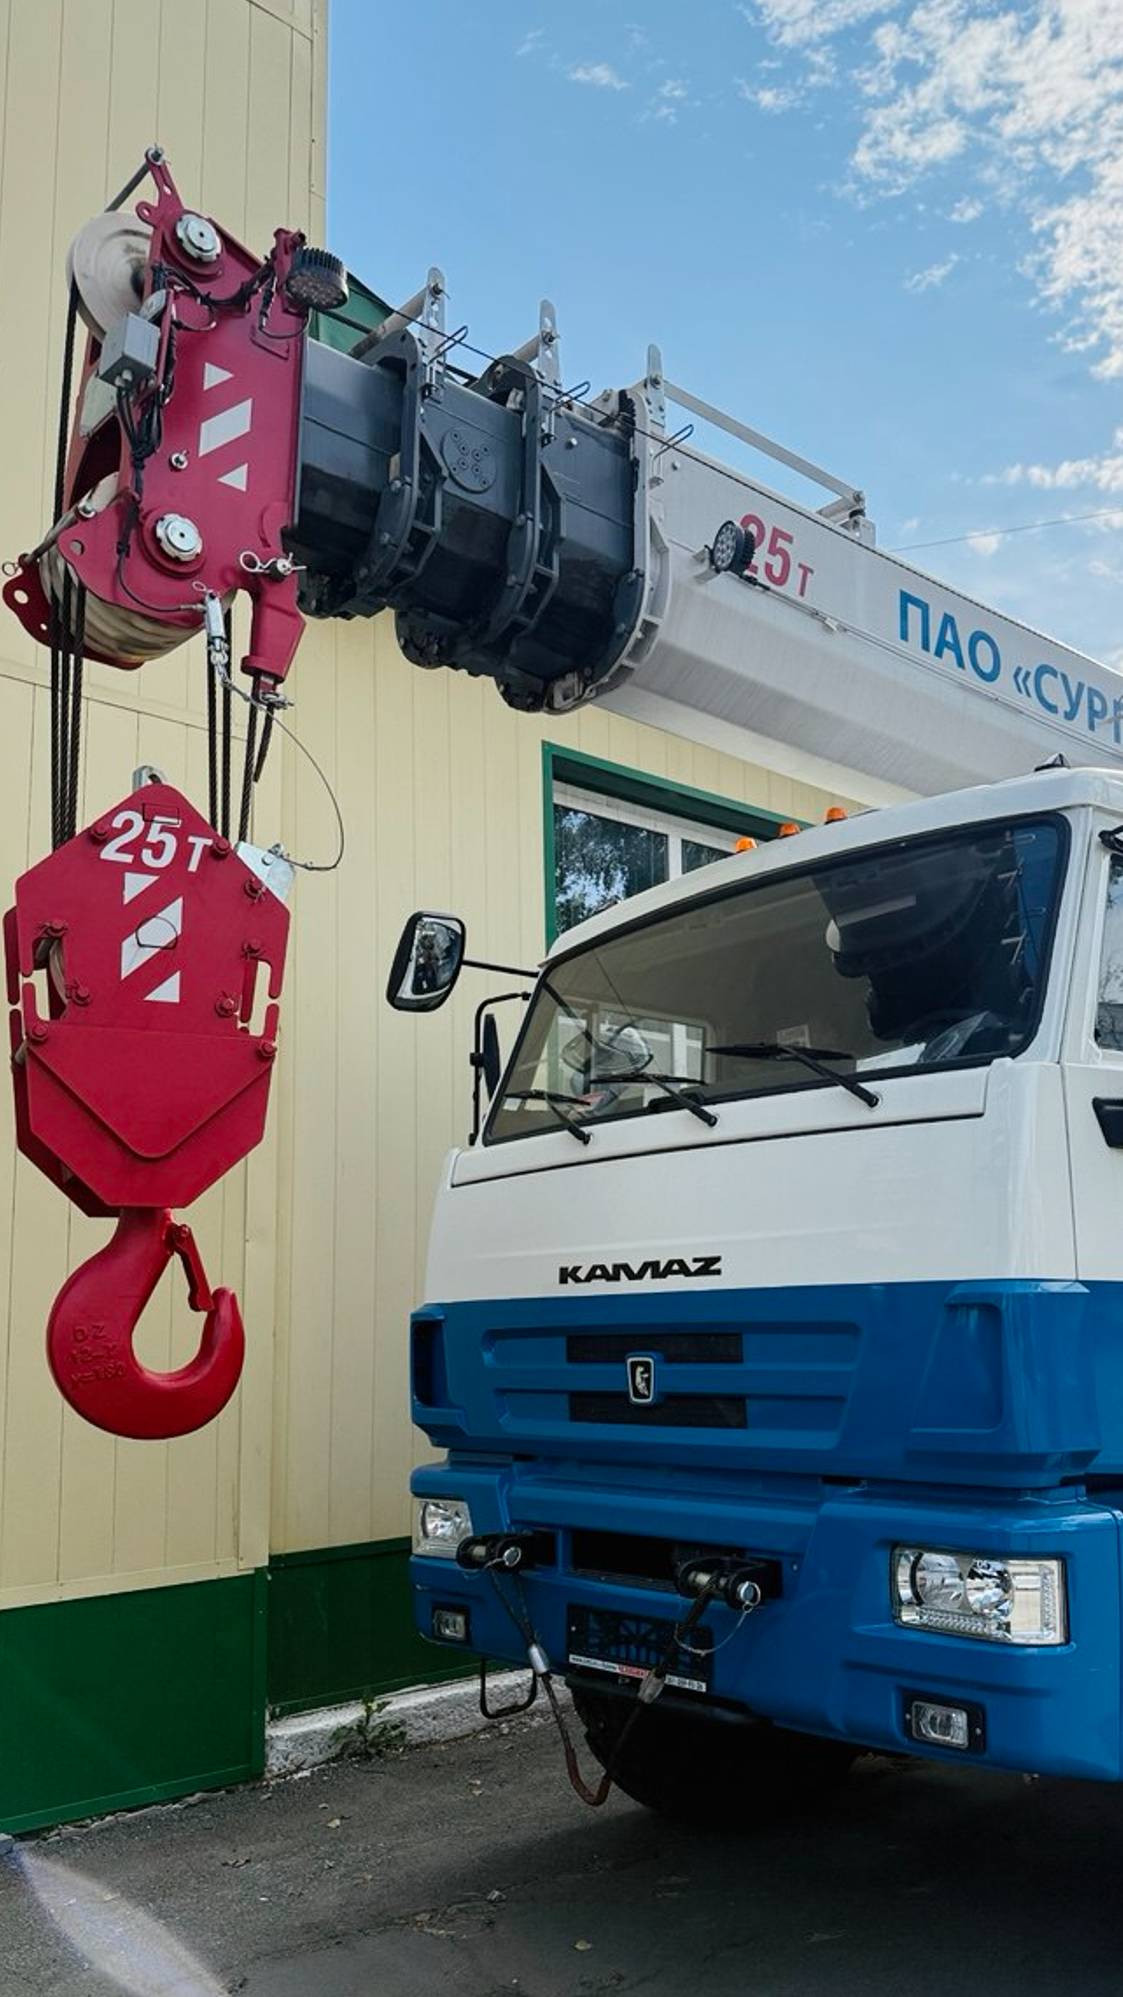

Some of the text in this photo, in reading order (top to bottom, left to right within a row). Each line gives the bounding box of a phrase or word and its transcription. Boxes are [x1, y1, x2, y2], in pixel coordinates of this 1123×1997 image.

[739, 513, 794, 586] 25
[899, 589, 1001, 683] ПАО
[100, 810, 182, 868] 25
[559, 1255, 722, 1284] KAMAZ
